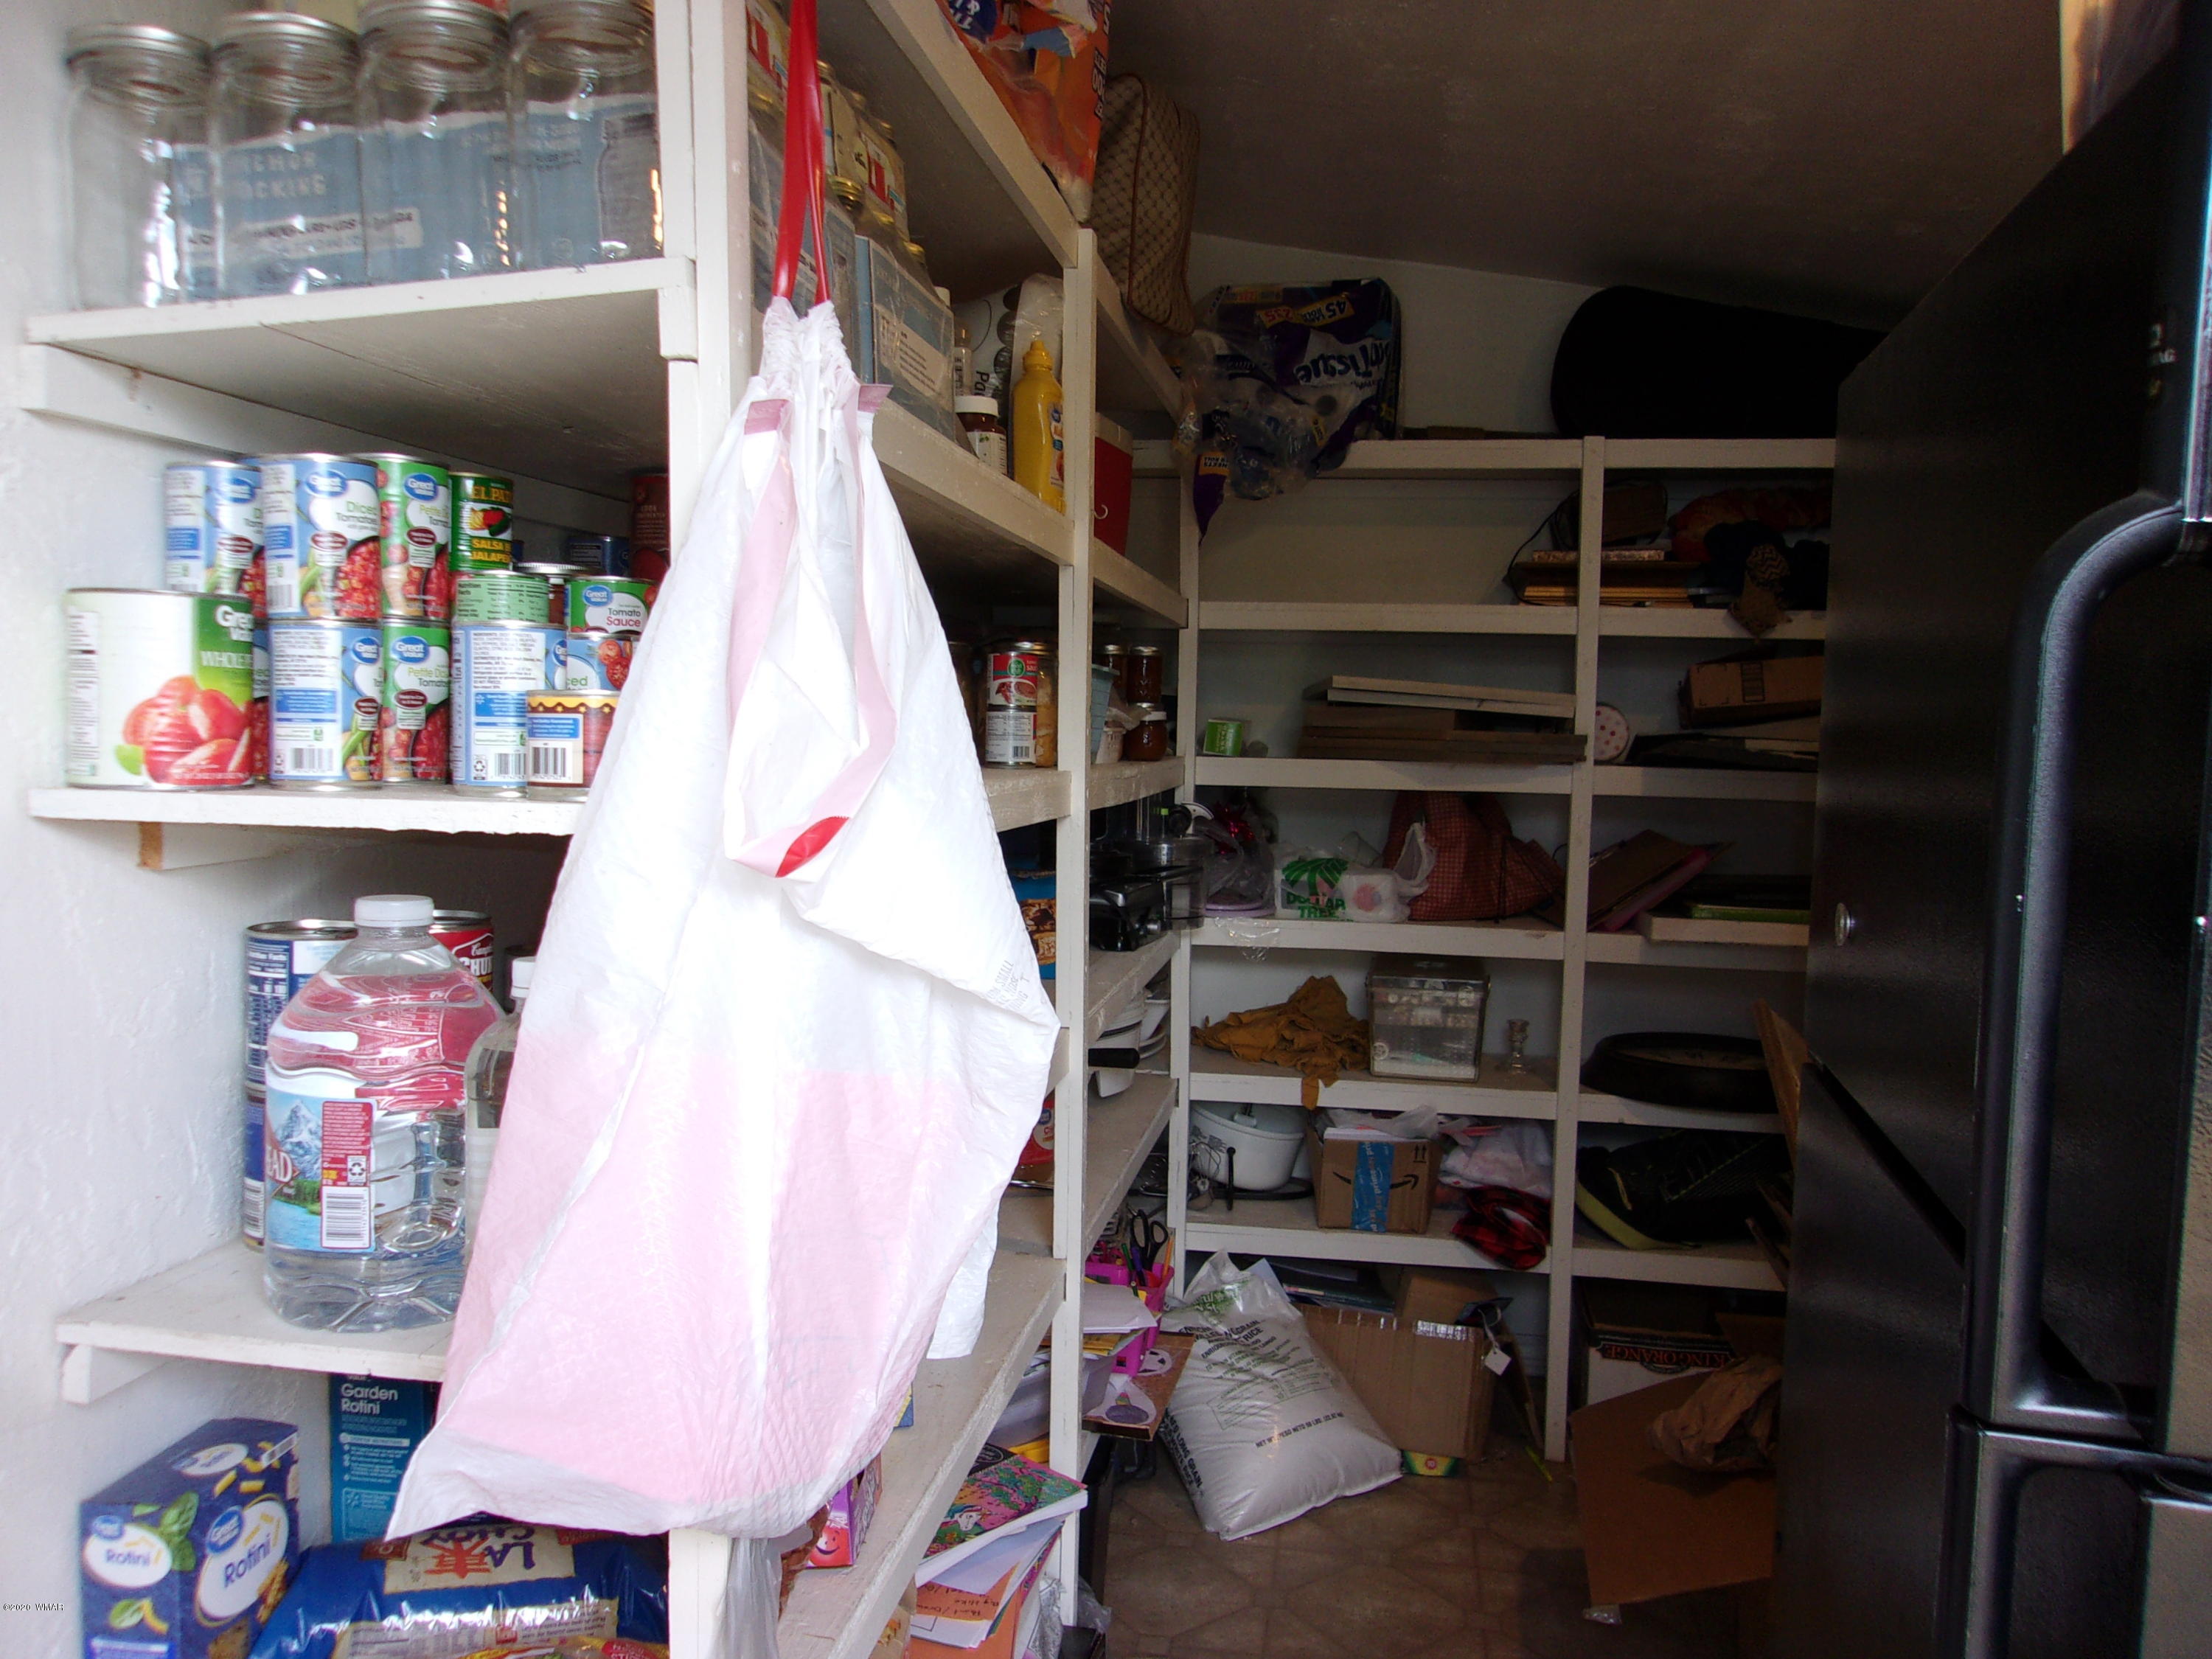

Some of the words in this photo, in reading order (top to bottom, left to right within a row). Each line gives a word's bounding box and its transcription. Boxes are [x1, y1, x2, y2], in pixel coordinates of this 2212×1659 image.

[1295, 344, 1373, 383] Tissue
[408, 479, 434, 490] Great
[472, 486, 485, 499] EL
[472, 538, 504, 552] SALSA
[587, 589, 608, 599] Great
[608, 607, 641, 617] Tomato
[606, 616, 641, 627] Sauce
[396, 641, 425, 653] Great
[408, 667, 434, 678] Petite
[1242, 1326, 1264, 1342] RICE
[1605, 1345, 1677, 1365] ORANGE
[341, 1382, 398, 1400] Garden
[341, 1399, 380, 1414] Rotini
[105, 1548, 151, 1567] Rotini
[224, 1533, 271, 1589] Rotini
[487, 1540, 536, 1570] LA
